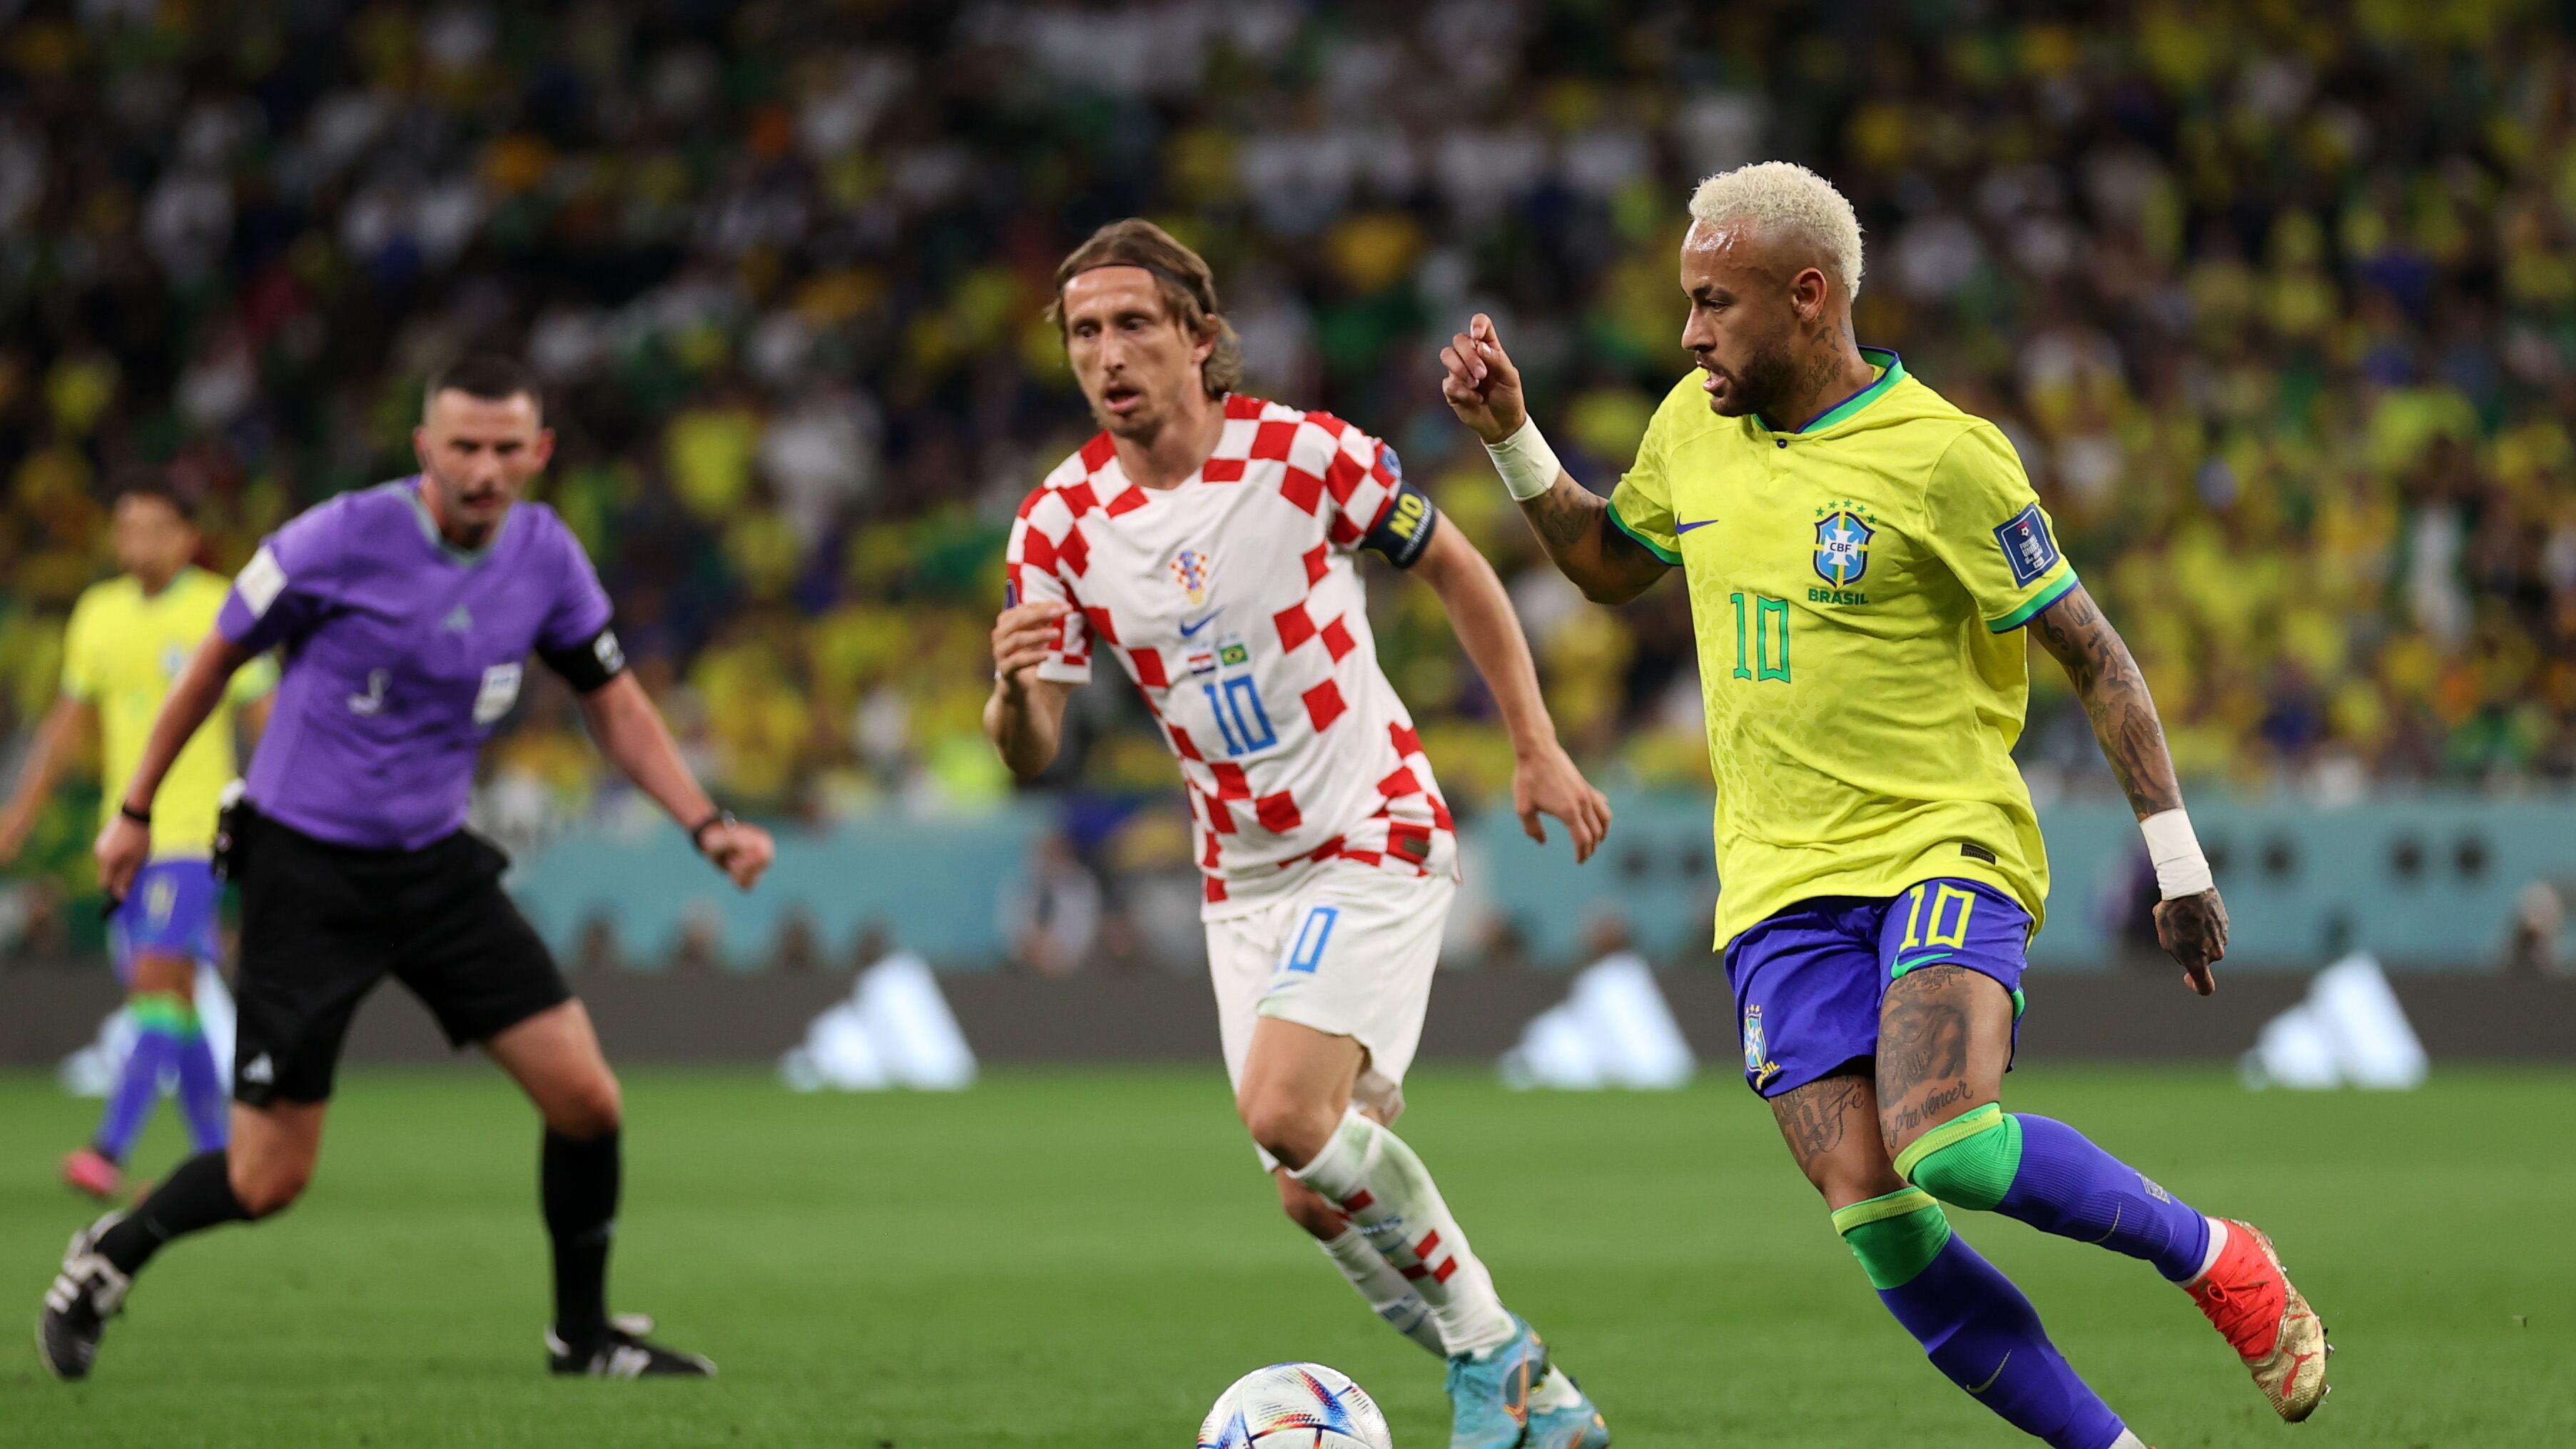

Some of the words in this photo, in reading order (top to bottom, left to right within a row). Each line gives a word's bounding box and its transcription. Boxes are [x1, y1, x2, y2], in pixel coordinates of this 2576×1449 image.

[1388, 493, 1424, 540] NO
[1830, 542, 1852, 553] CBF
[1808, 588, 1869, 605] BRASIL
[1730, 592, 1791, 684] 10
[1202, 674, 1278, 757] 10
[1284, 907, 1339, 974] 0
[1898, 882, 1976, 952] 10
[1756, 1060, 1780, 1090] SIL
